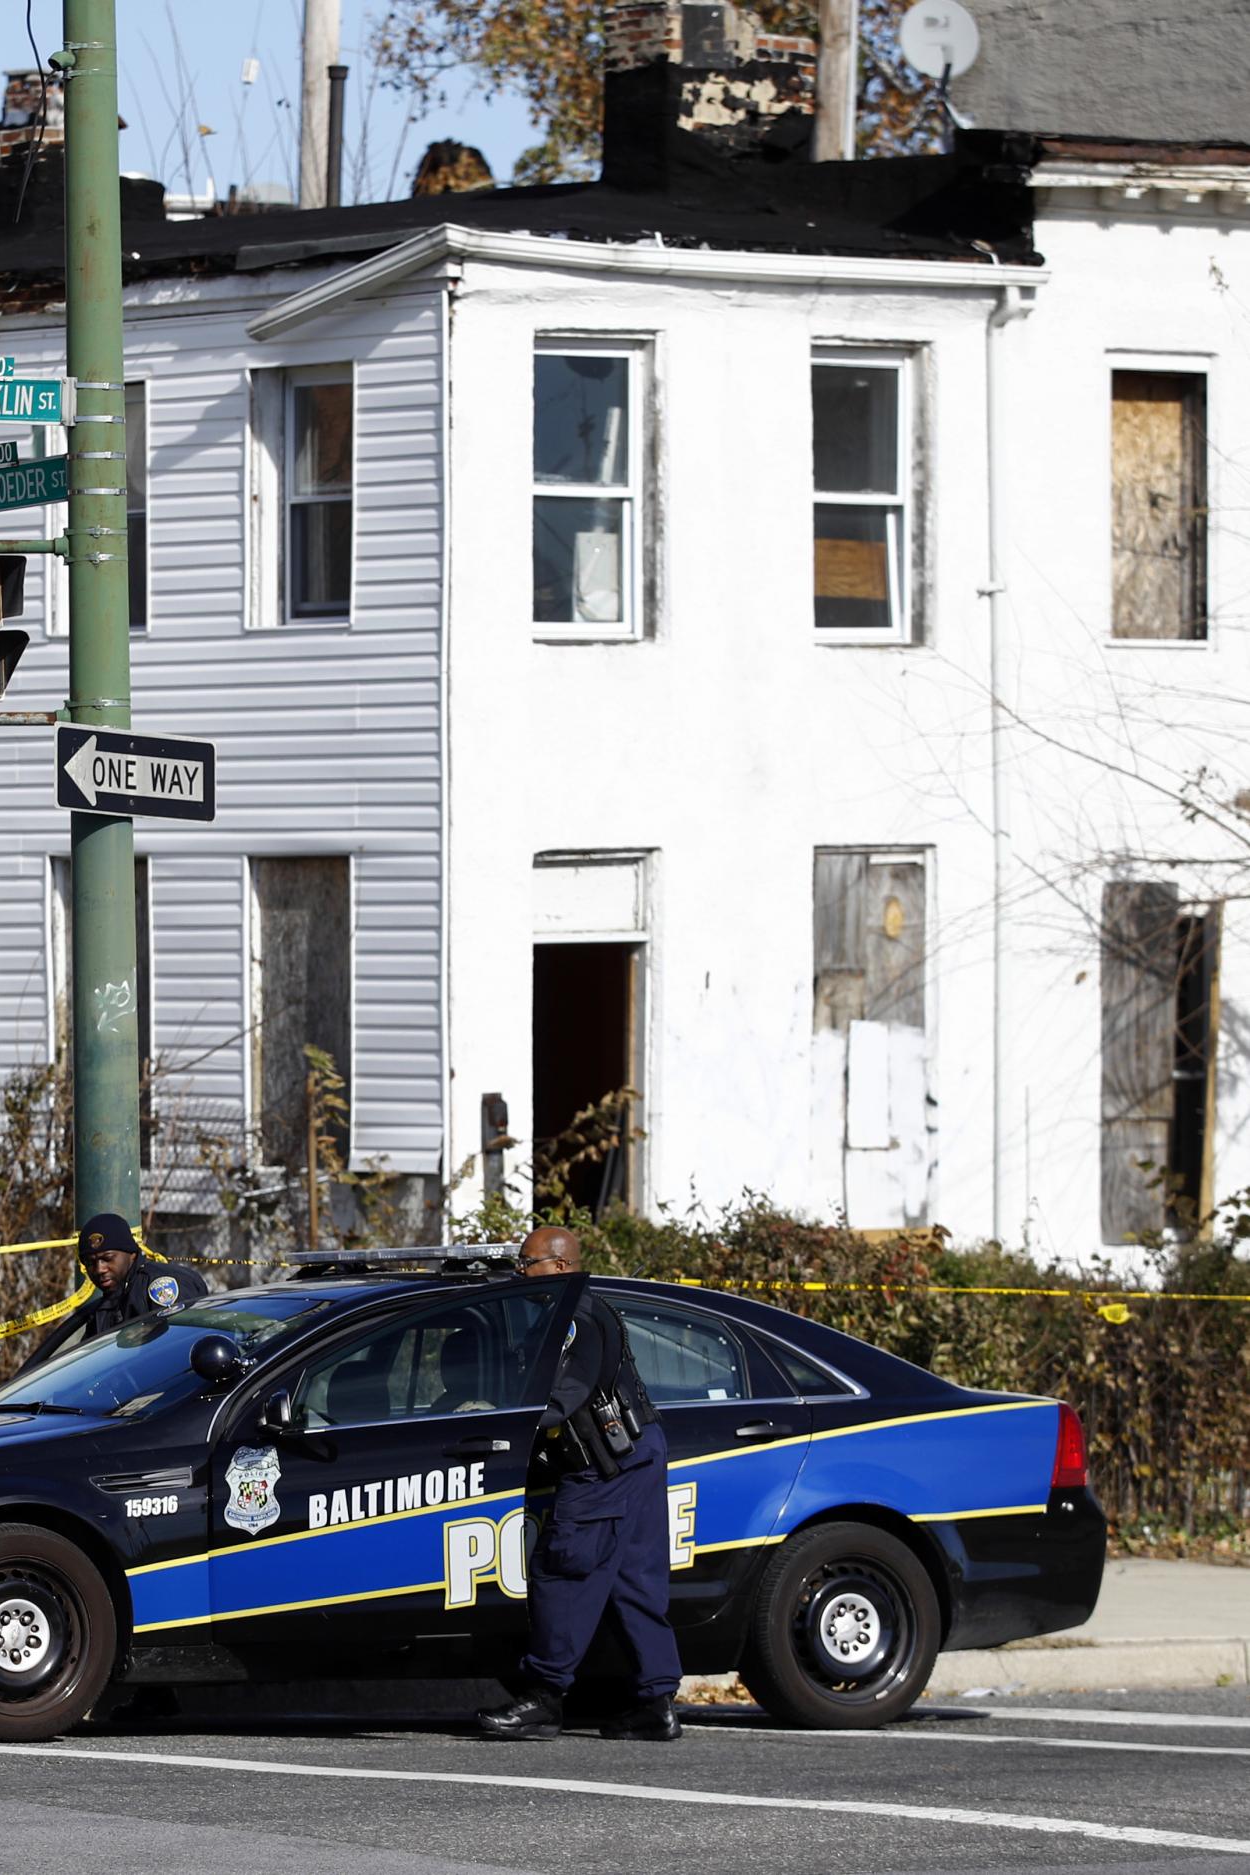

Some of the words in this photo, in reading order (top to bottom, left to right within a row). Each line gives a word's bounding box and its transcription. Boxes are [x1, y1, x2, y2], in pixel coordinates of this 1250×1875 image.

[38, 392, 57, 410] ST.
[93, 756, 137, 790] ONE
[150, 762, 199, 796] WAY
[124, 1495, 178, 1518] 159316
[309, 1461, 485, 1529] BALTIMORE
